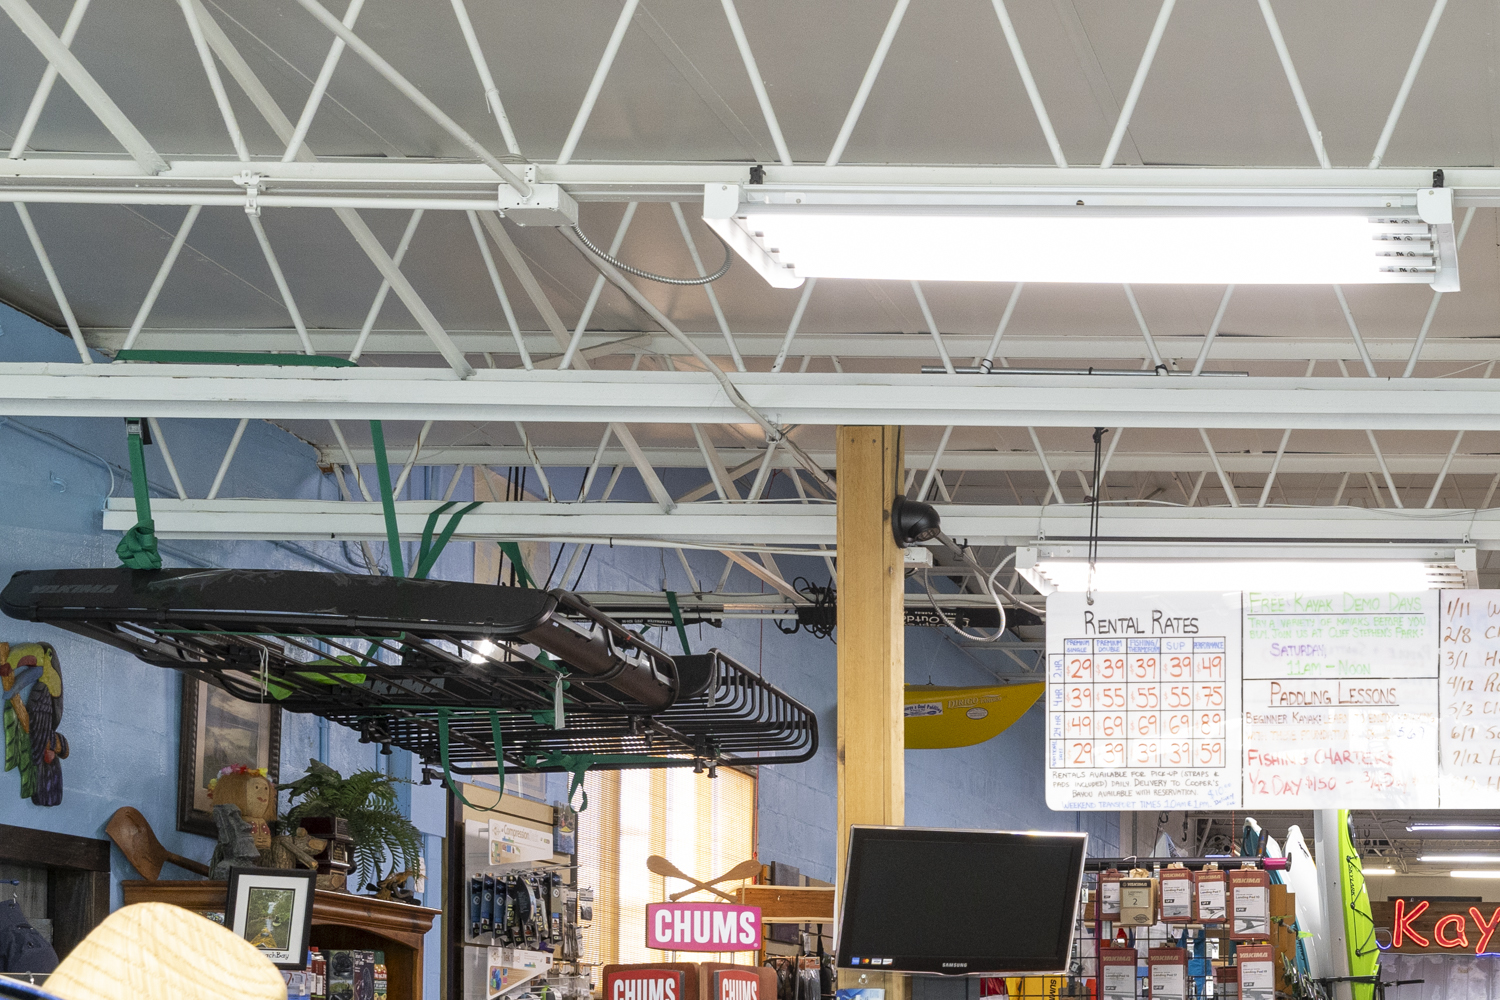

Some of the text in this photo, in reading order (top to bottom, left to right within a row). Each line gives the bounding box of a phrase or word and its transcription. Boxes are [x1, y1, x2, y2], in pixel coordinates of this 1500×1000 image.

[1249, 592, 1422, 612] FREE KAYAK DEMO DAYS
[1084, 610, 1199, 634] RENTAL RATES
[1248, 616, 1426, 628] TRY VARIETY OF KAYAKS BEFORE YOU
[1272, 628, 1292, 638] JOIN
[1296, 630, 1308, 638] US
[1312, 629, 1324, 638] AT
[1328, 627, 1350, 638] CLIFF
[1444, 626, 1472, 644] 2/8
[1166, 642, 1186, 650] SUP
[1193, 642, 1224, 650] PERFORMANCE
[1338, 660, 1370, 675] NOON
[1446, 674, 1474, 696] 4/12
[1270, 681, 1397, 706] PADDLING LESSONS
[1246, 712, 1288, 724] BEGINNER
[1248, 748, 1308, 766] FISHING
[1052, 770, 1086, 778] RENTALS
[1074, 780, 1108, 788] INCLUDED)
[1134, 779, 1167, 787] DELIVERY
[1185, 779, 1219, 787] COOPER'S
[1272, 774, 1336, 796] DAY $150
[1062, 800, 1096, 809] WEEKEND
[1098, 800, 1136, 808] TRANSPORT
[1140, 800, 1162, 808] TIMES
[1132, 898, 1138, 906] 2
[654, 908, 756, 944] CHUMS
